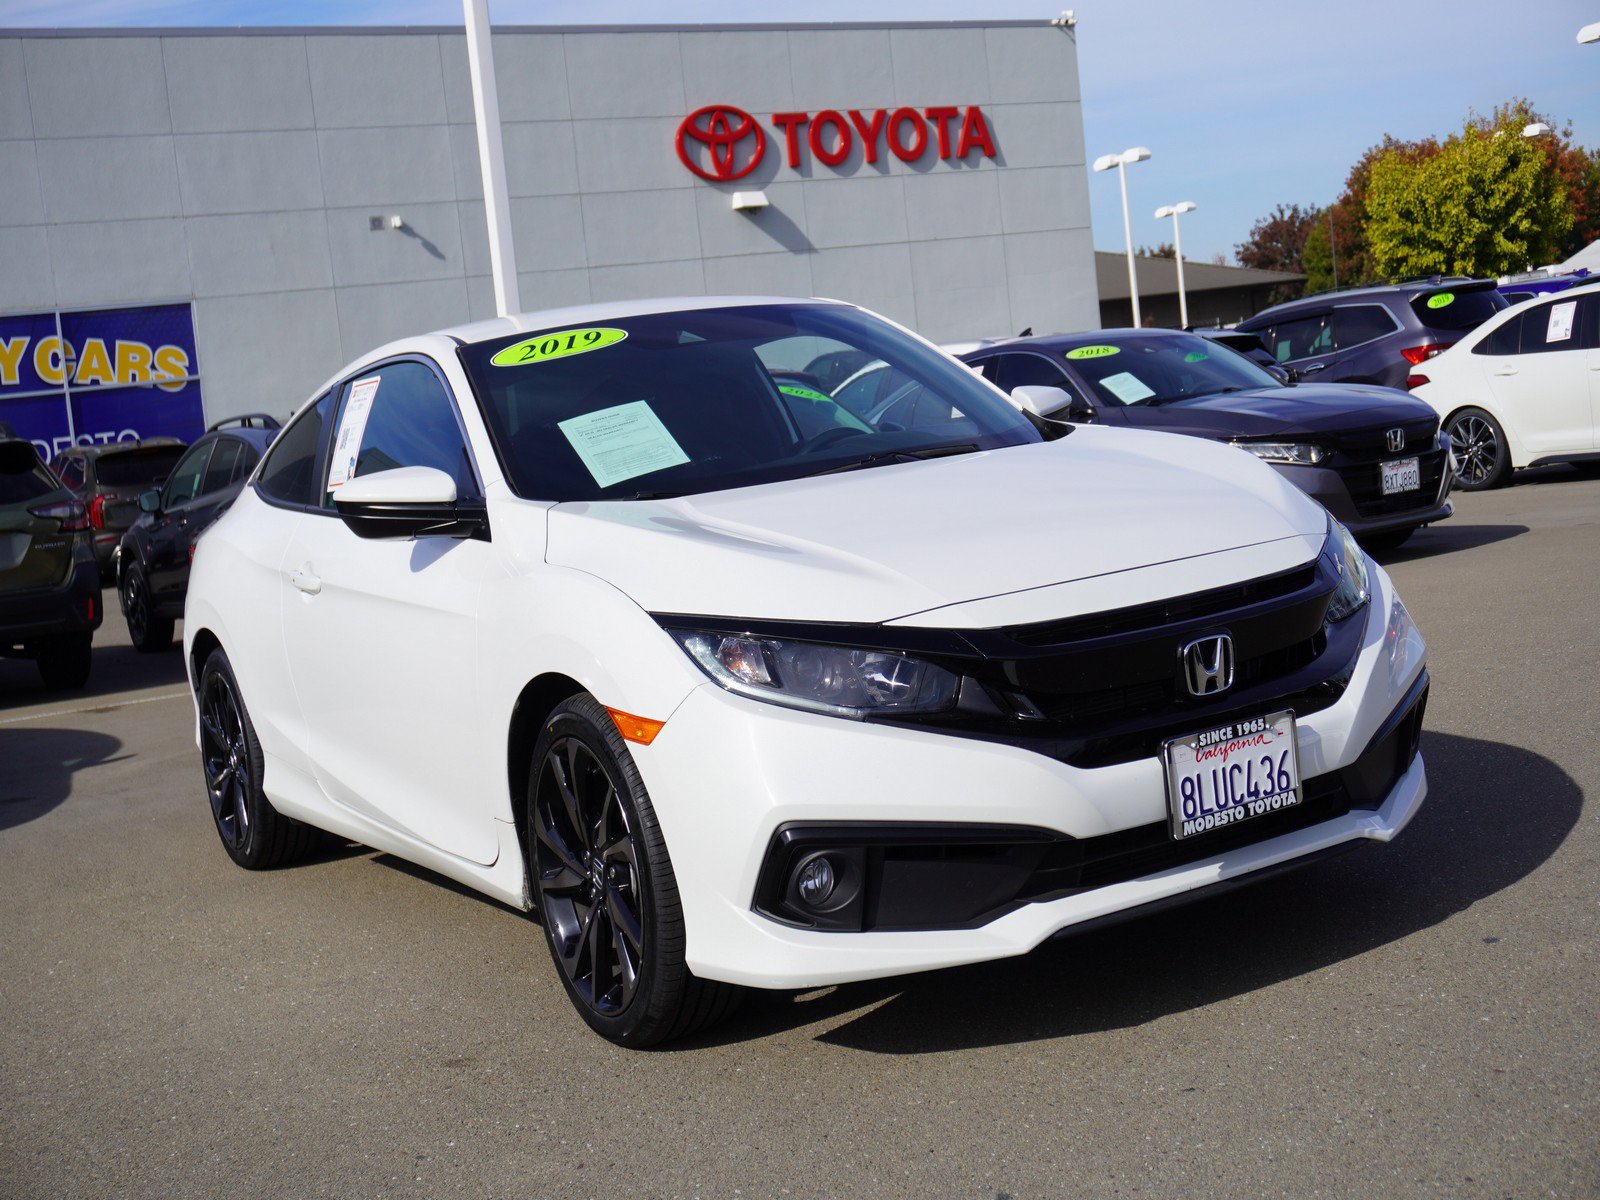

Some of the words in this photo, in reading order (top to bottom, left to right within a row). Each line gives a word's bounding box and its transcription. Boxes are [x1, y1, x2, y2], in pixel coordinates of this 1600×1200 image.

[772, 106, 996, 168] TOYOTA
[34, 335, 189, 392] CARS
[518, 331, 602, 362] 2019
[1078, 346, 1110, 358] 2018
[1195, 733, 1272, 763] California
[1198, 727, 1233, 746] SINCE
[1236, 718, 1265, 736] 1965
[1180, 750, 1291, 819] 8LUC436
[1183, 806, 1245, 836] MODESTO
[1248, 791, 1297, 816] TOYOTA
